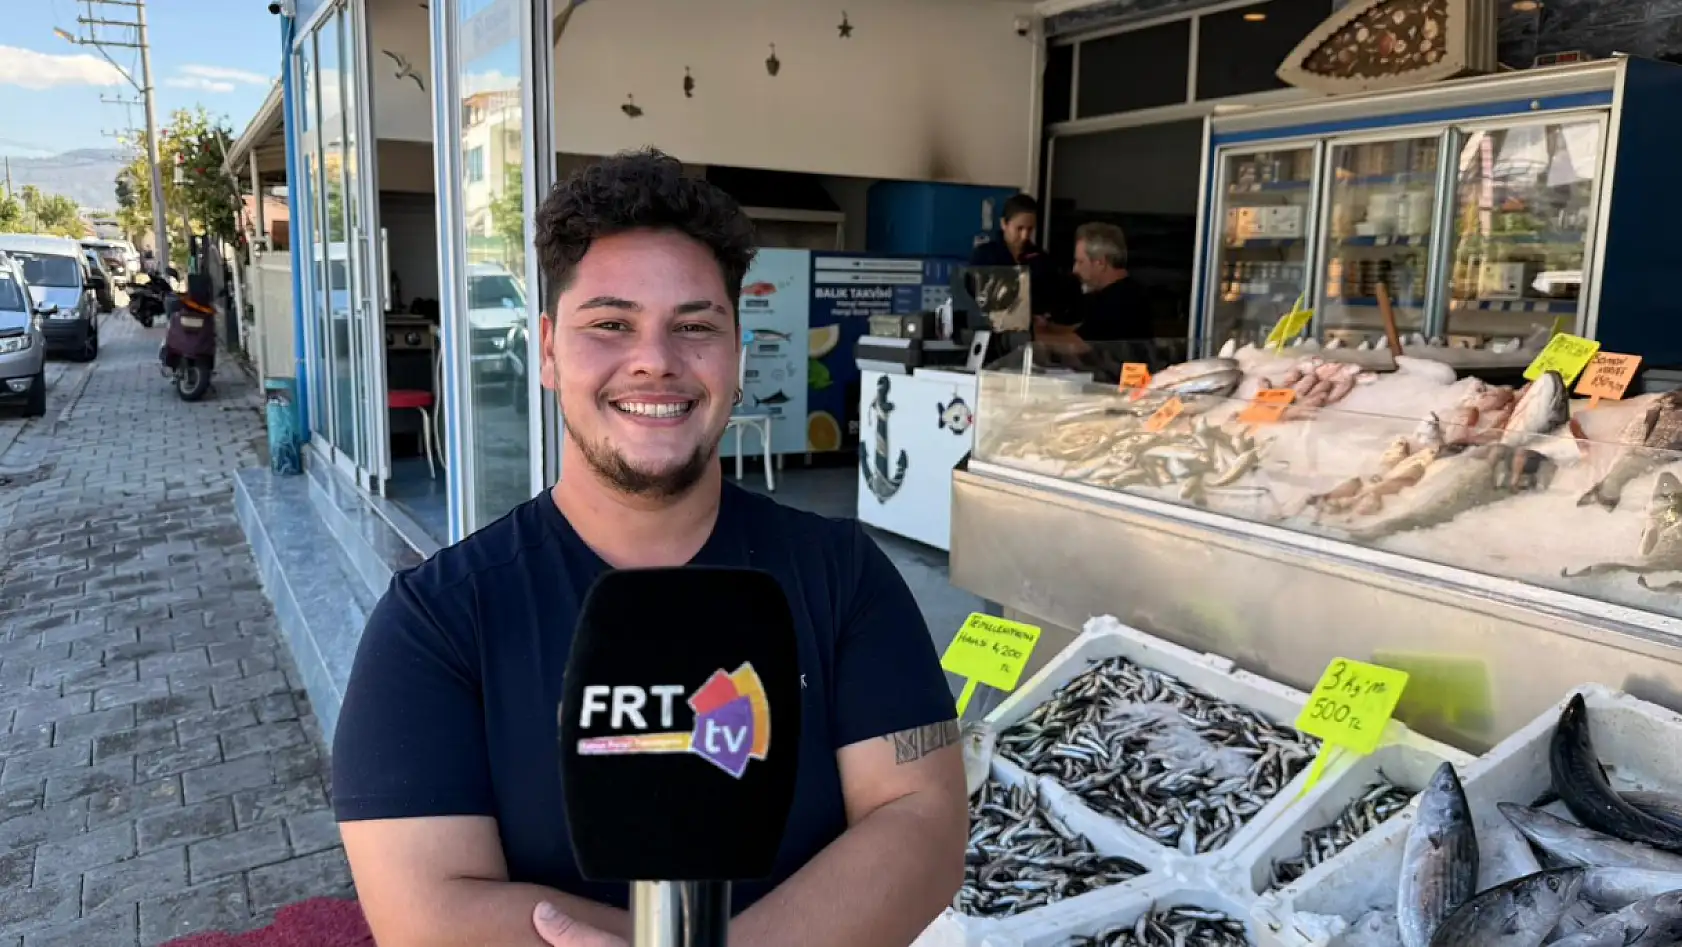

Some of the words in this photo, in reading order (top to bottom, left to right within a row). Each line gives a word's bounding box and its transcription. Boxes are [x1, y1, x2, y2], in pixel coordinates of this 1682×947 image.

[814, 287, 848, 298] BALIK
[1323, 661, 1346, 690] 3
[579, 685, 685, 729] FRT
[705, 719, 748, 753] tv
